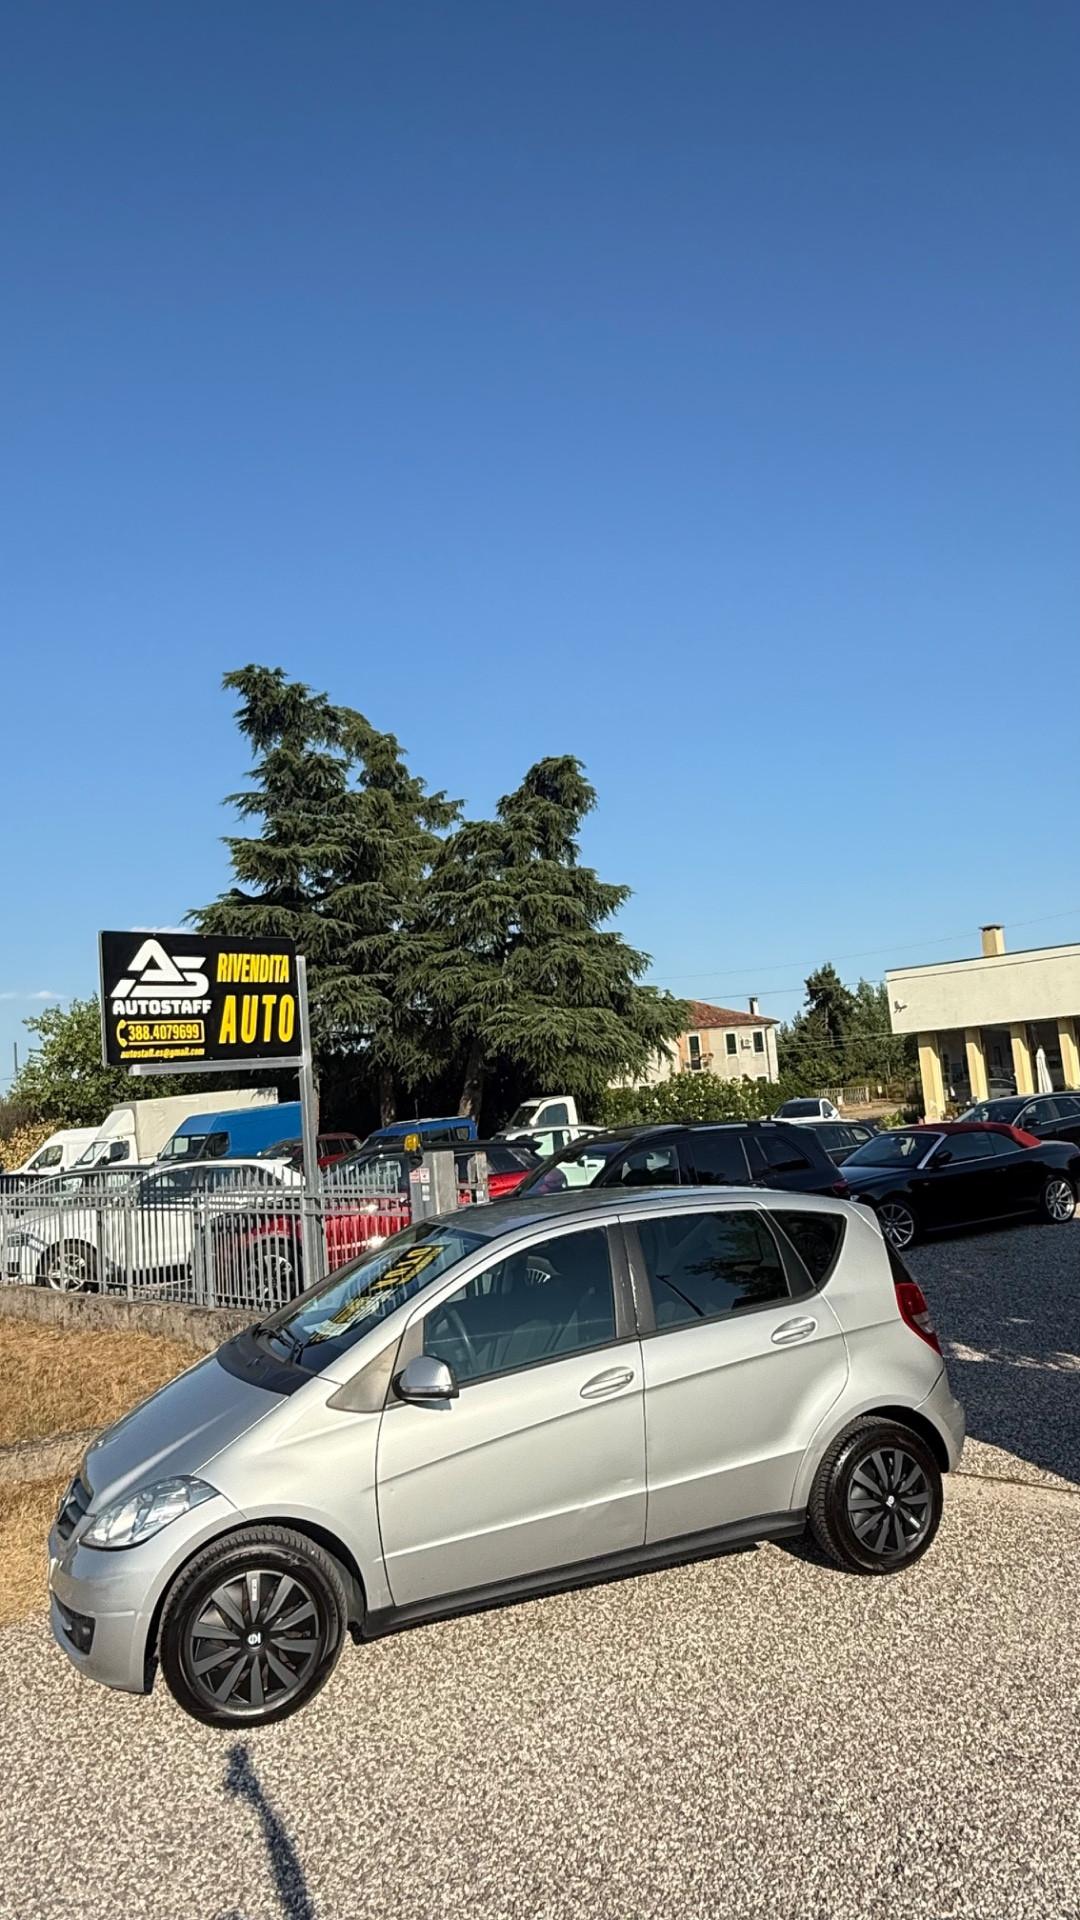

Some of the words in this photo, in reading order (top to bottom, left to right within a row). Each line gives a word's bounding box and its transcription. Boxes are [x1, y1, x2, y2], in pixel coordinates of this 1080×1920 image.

[217, 953, 290, 983] RIVENDITA
[113, 999, 212, 1015] AUTOSTAFF
[219, 994, 295, 1044] AUTO
[128, 1023, 200, 1041] 388.4079699
